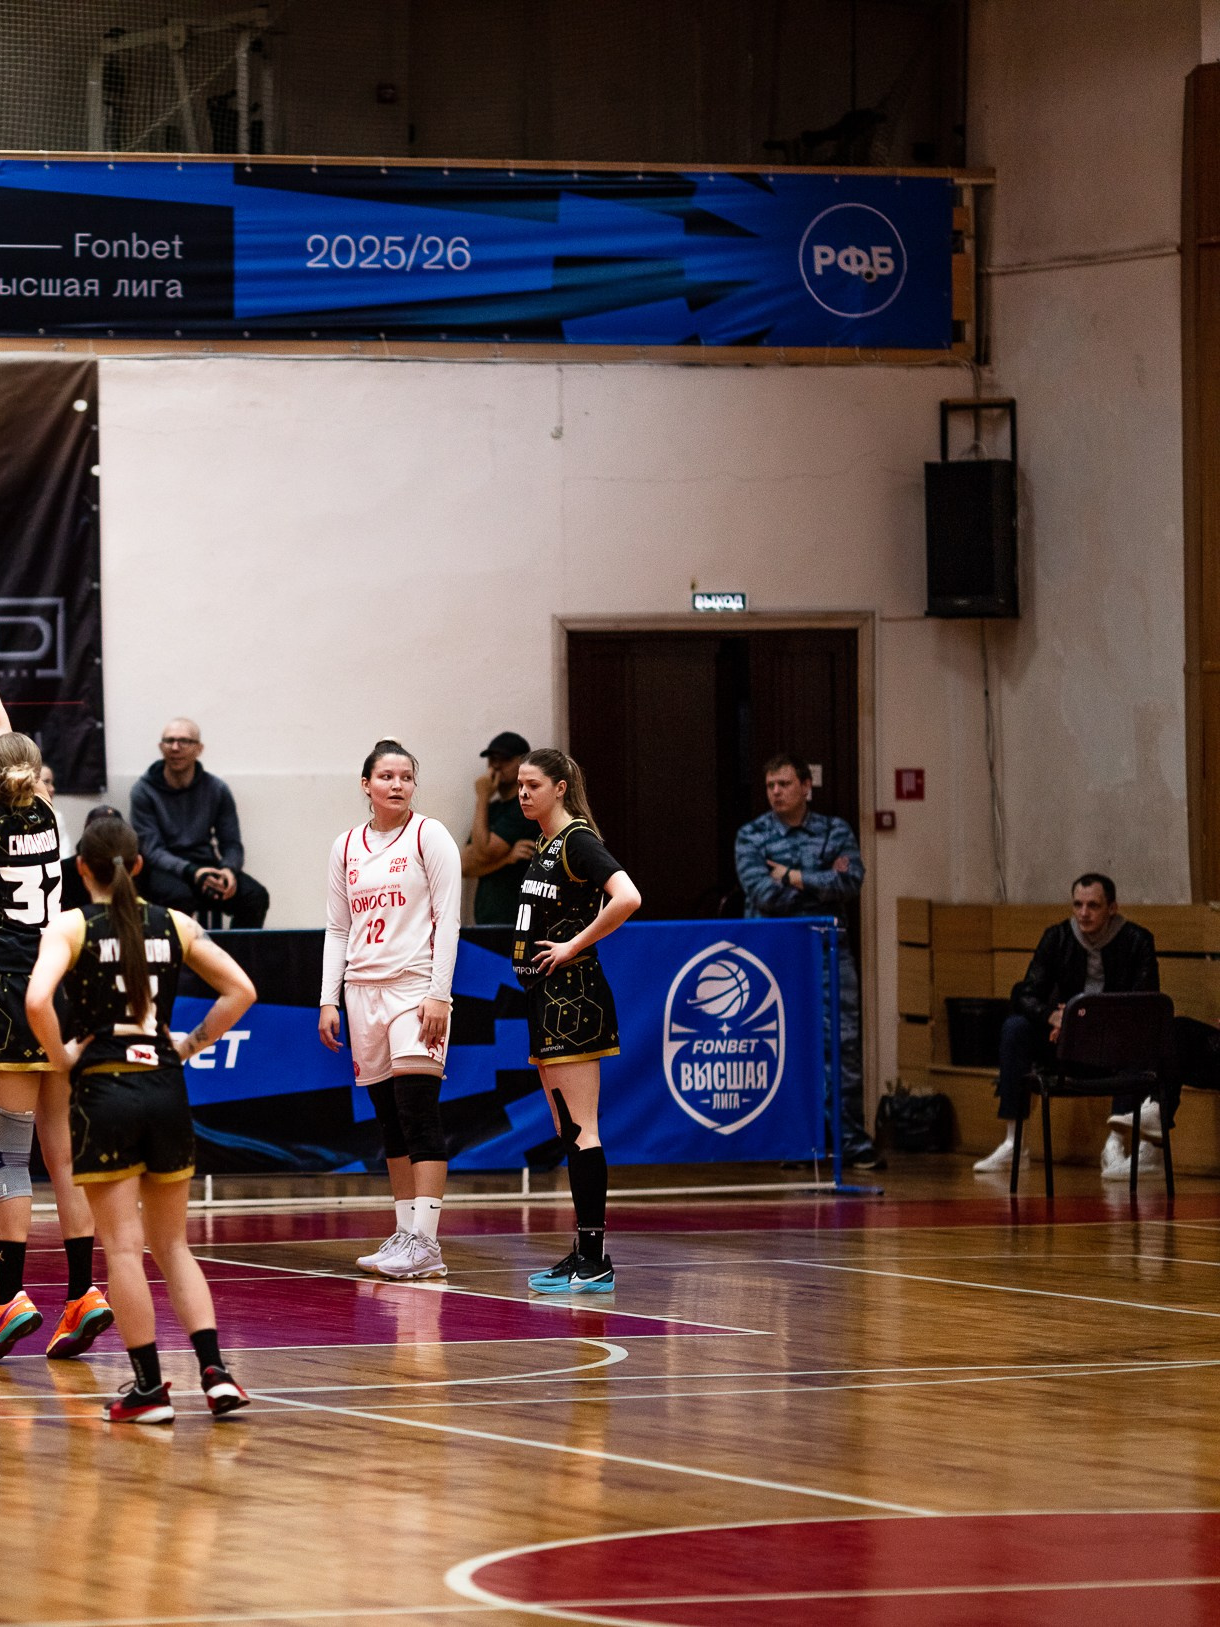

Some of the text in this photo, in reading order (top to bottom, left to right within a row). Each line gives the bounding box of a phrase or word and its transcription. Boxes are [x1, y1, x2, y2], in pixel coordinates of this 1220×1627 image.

[74, 233, 184, 260] Fonbet
[305, 234, 472, 272] 2025/26
[813, 243, 894, 276] РФБ
[113, 276, 184, 299] лига
[389, 864, 408, 873] BET
[351, 891, 407, 914] ЮНОСТЬ
[367, 918, 385, 945] 12
[692, 1038, 760, 1055] FONBET
[681, 1061, 768, 1090] ВЫСШАЯ
[711, 1092, 741, 1110] ЛИГА
